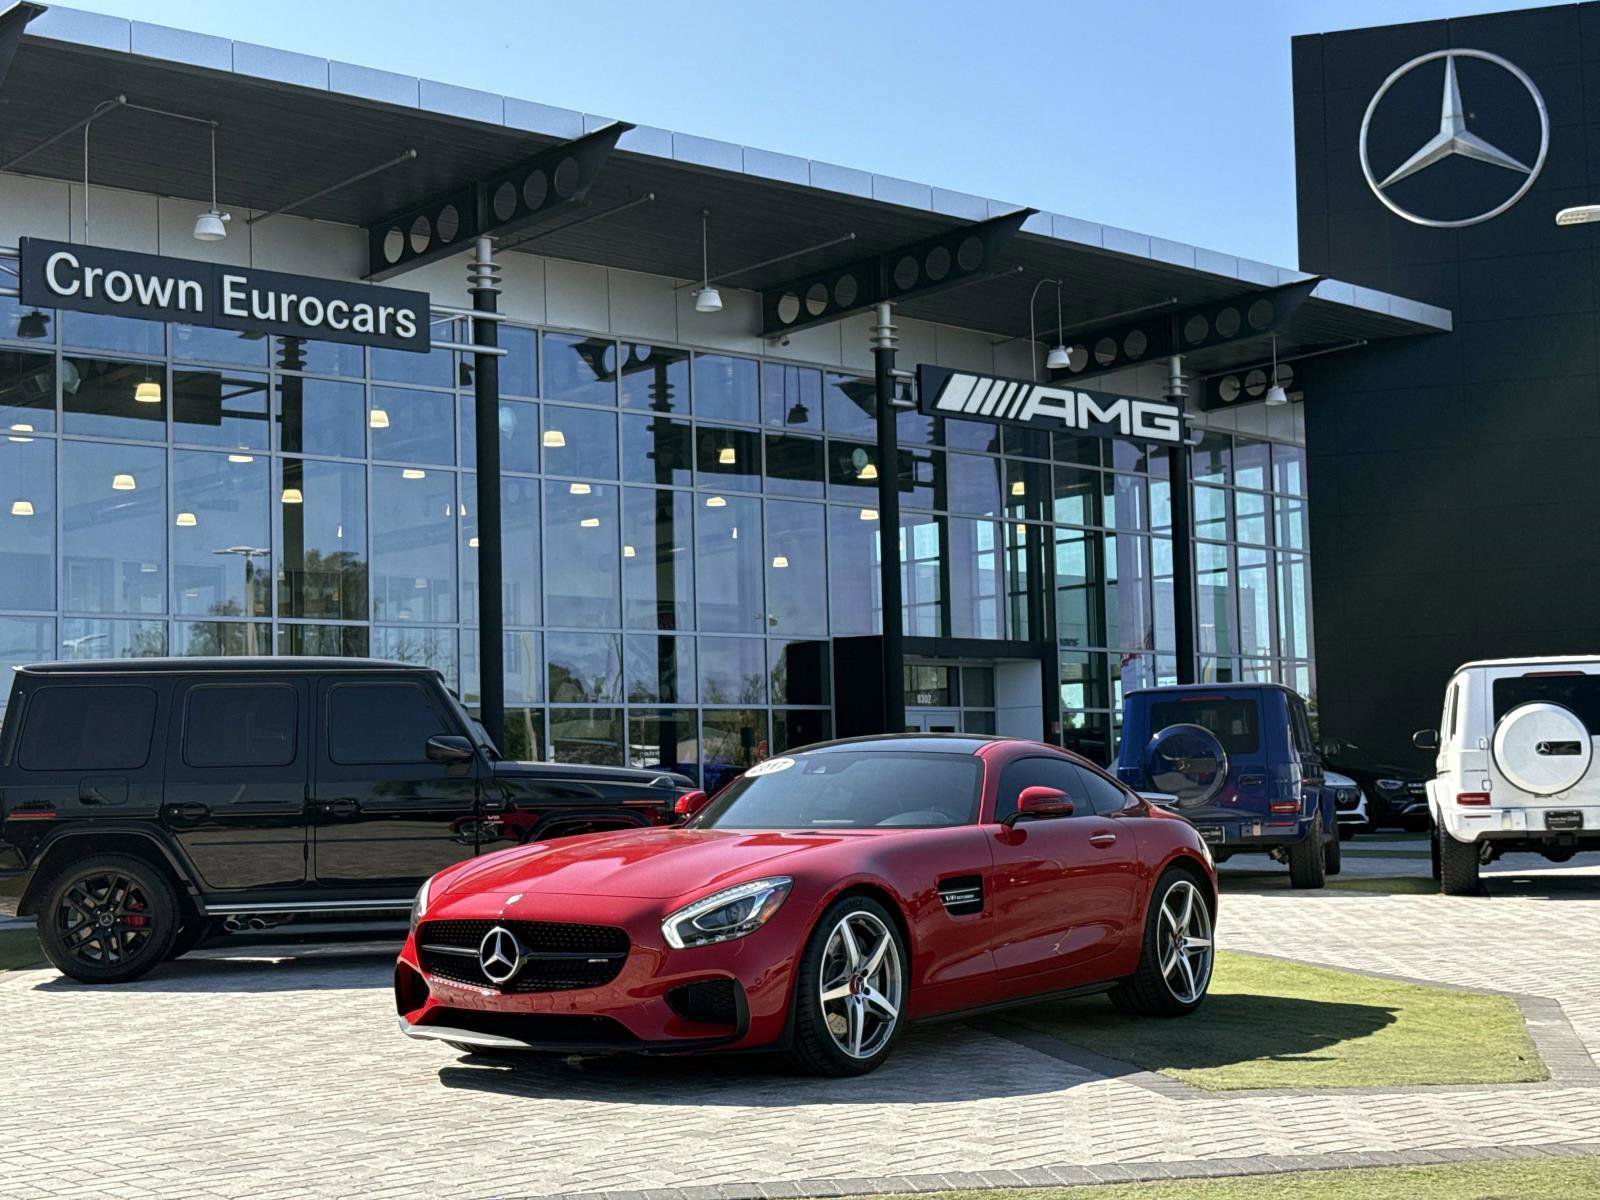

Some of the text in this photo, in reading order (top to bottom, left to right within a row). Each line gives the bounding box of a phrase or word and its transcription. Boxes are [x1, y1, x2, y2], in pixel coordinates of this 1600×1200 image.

[45, 251, 418, 339] Crown Eurocars
[1018, 385, 1180, 441] AMG
